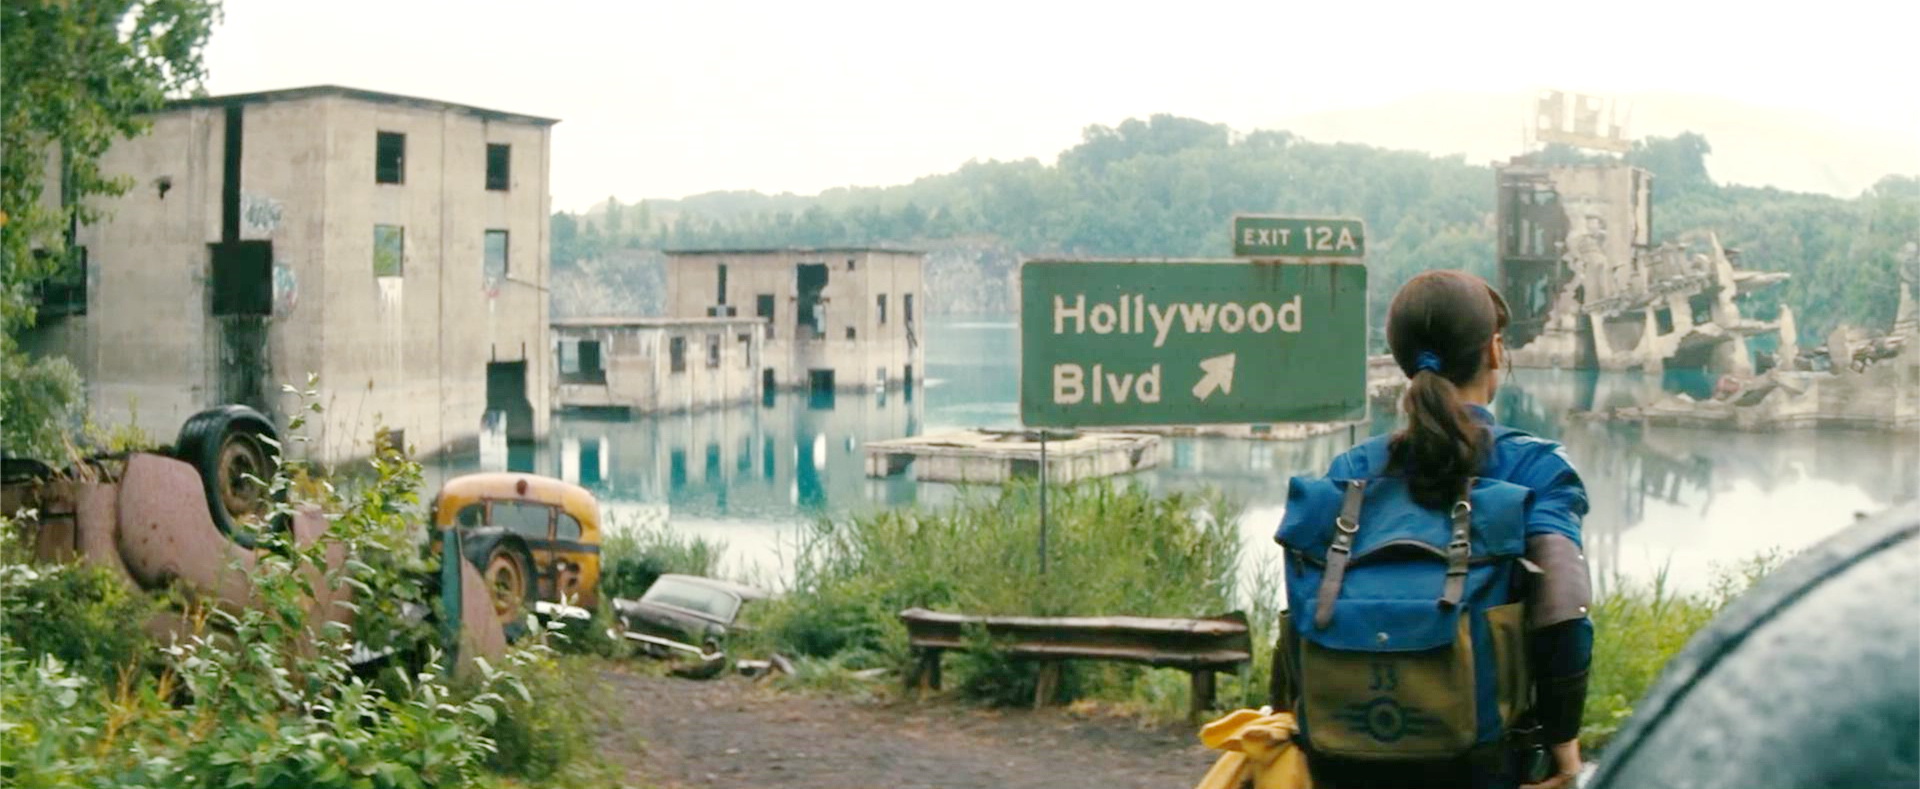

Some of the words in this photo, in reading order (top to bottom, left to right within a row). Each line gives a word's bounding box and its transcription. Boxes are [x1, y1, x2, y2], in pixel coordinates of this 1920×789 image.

[1243, 228, 1291, 246] EXIT
[1304, 226, 1356, 251] 12A
[1053, 294, 1302, 347] Hollywood
[1053, 363, 1161, 404] Blvd
[1368, 662, 1397, 691] 33
